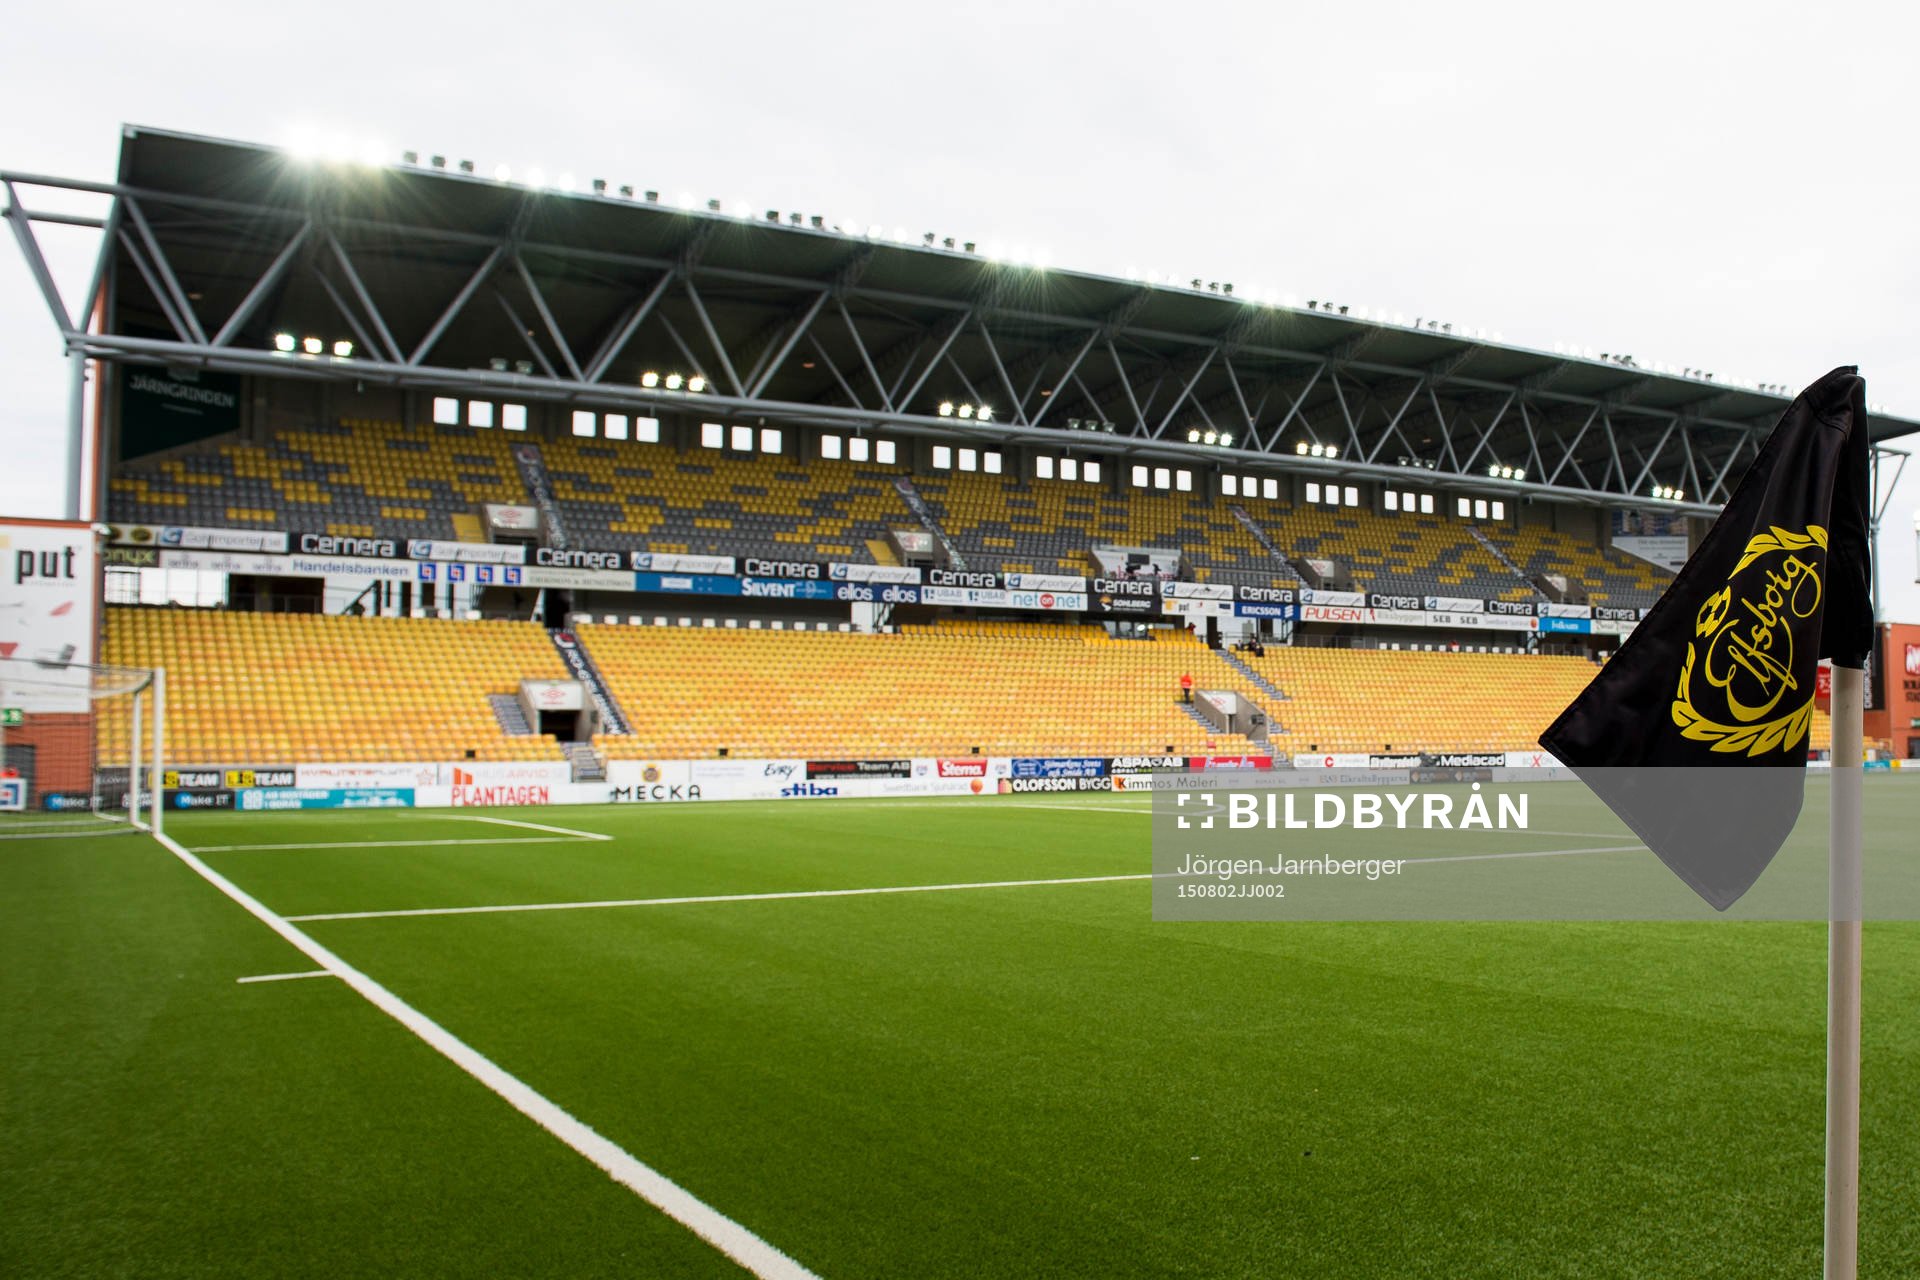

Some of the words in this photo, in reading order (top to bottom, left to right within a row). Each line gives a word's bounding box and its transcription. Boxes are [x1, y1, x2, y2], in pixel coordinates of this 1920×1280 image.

[129, 375, 235, 408] JÄRNGRINDEN
[17, 545, 75, 584] put
[292, 559, 410, 576] Handelsbanken
[837, 583, 874, 601] ellos
[882, 584, 917, 603] ellos
[1242, 605, 1281, 617] ERICSSON
[1305, 606, 1362, 621] PULSEN
[1433, 615, 1451, 624] SEB
[1460, 616, 1478, 625] SEB
[781, 783, 838, 797] stiba
[1013, 778, 1076, 791] OLOFSSON
[1079, 777, 1111, 791] BYGG
[1118, 777, 1171, 790] Kimmos
[451, 786, 549, 806] PLANTAGEN
[615, 784, 701, 800] MECKA
[180, 794, 213, 806] Make
[214, 794, 229, 806] IT
